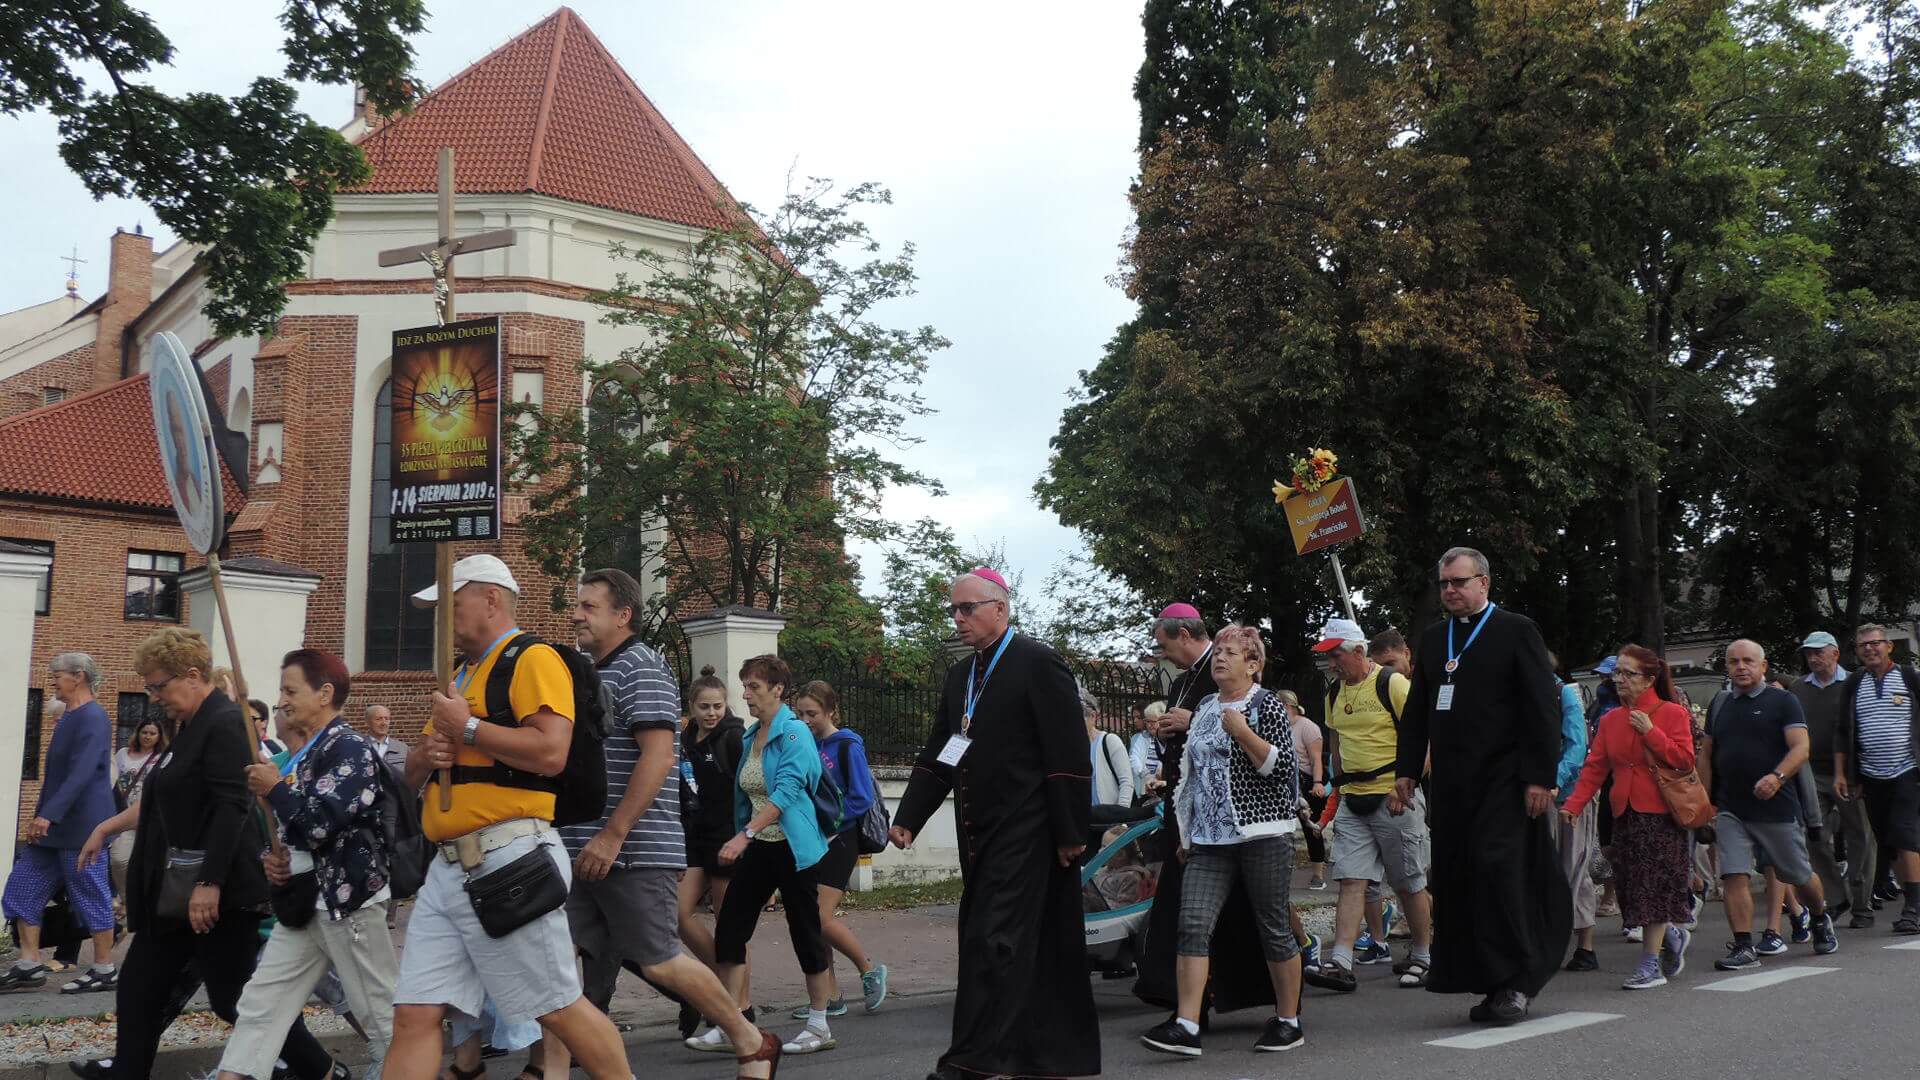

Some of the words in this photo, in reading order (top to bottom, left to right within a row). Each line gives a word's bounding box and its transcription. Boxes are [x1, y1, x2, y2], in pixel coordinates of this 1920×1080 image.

[414, 335, 424, 344] ZA
[457, 326, 496, 338] DUCHEM
[390, 485, 416, 514] 1-14
[418, 483, 461, 502] SIERPNIA
[462, 481, 487, 500] 2019
[488, 486, 495, 498] r.
[396, 520, 416, 529] Zapisy
